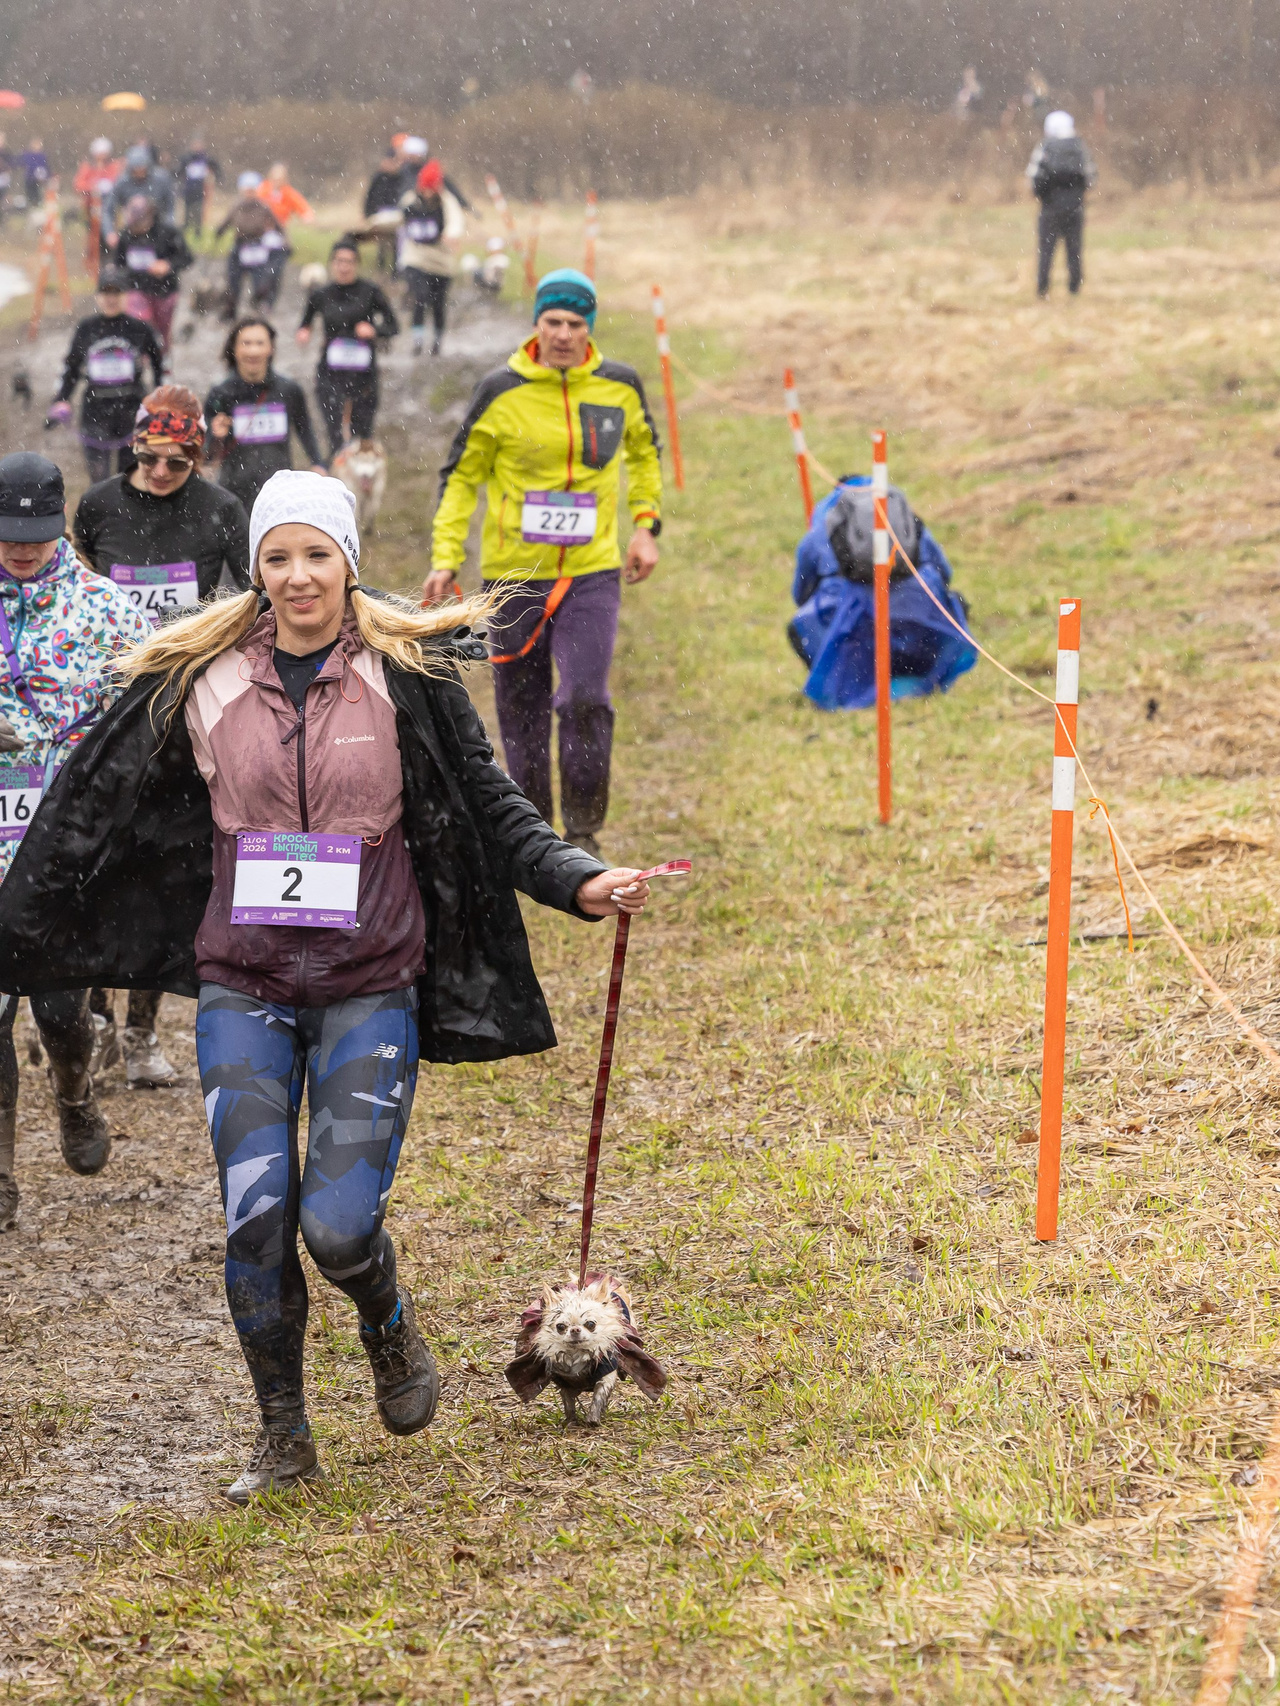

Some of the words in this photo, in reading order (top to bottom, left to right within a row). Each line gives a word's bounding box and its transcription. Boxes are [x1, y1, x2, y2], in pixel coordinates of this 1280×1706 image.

[541, 511, 580, 531] 227
[130, 589, 178, 611] 245
[342, 734, 375, 744] Columbia
[243, 844, 266, 852] 2026
[281, 867, 303, 902] 2
